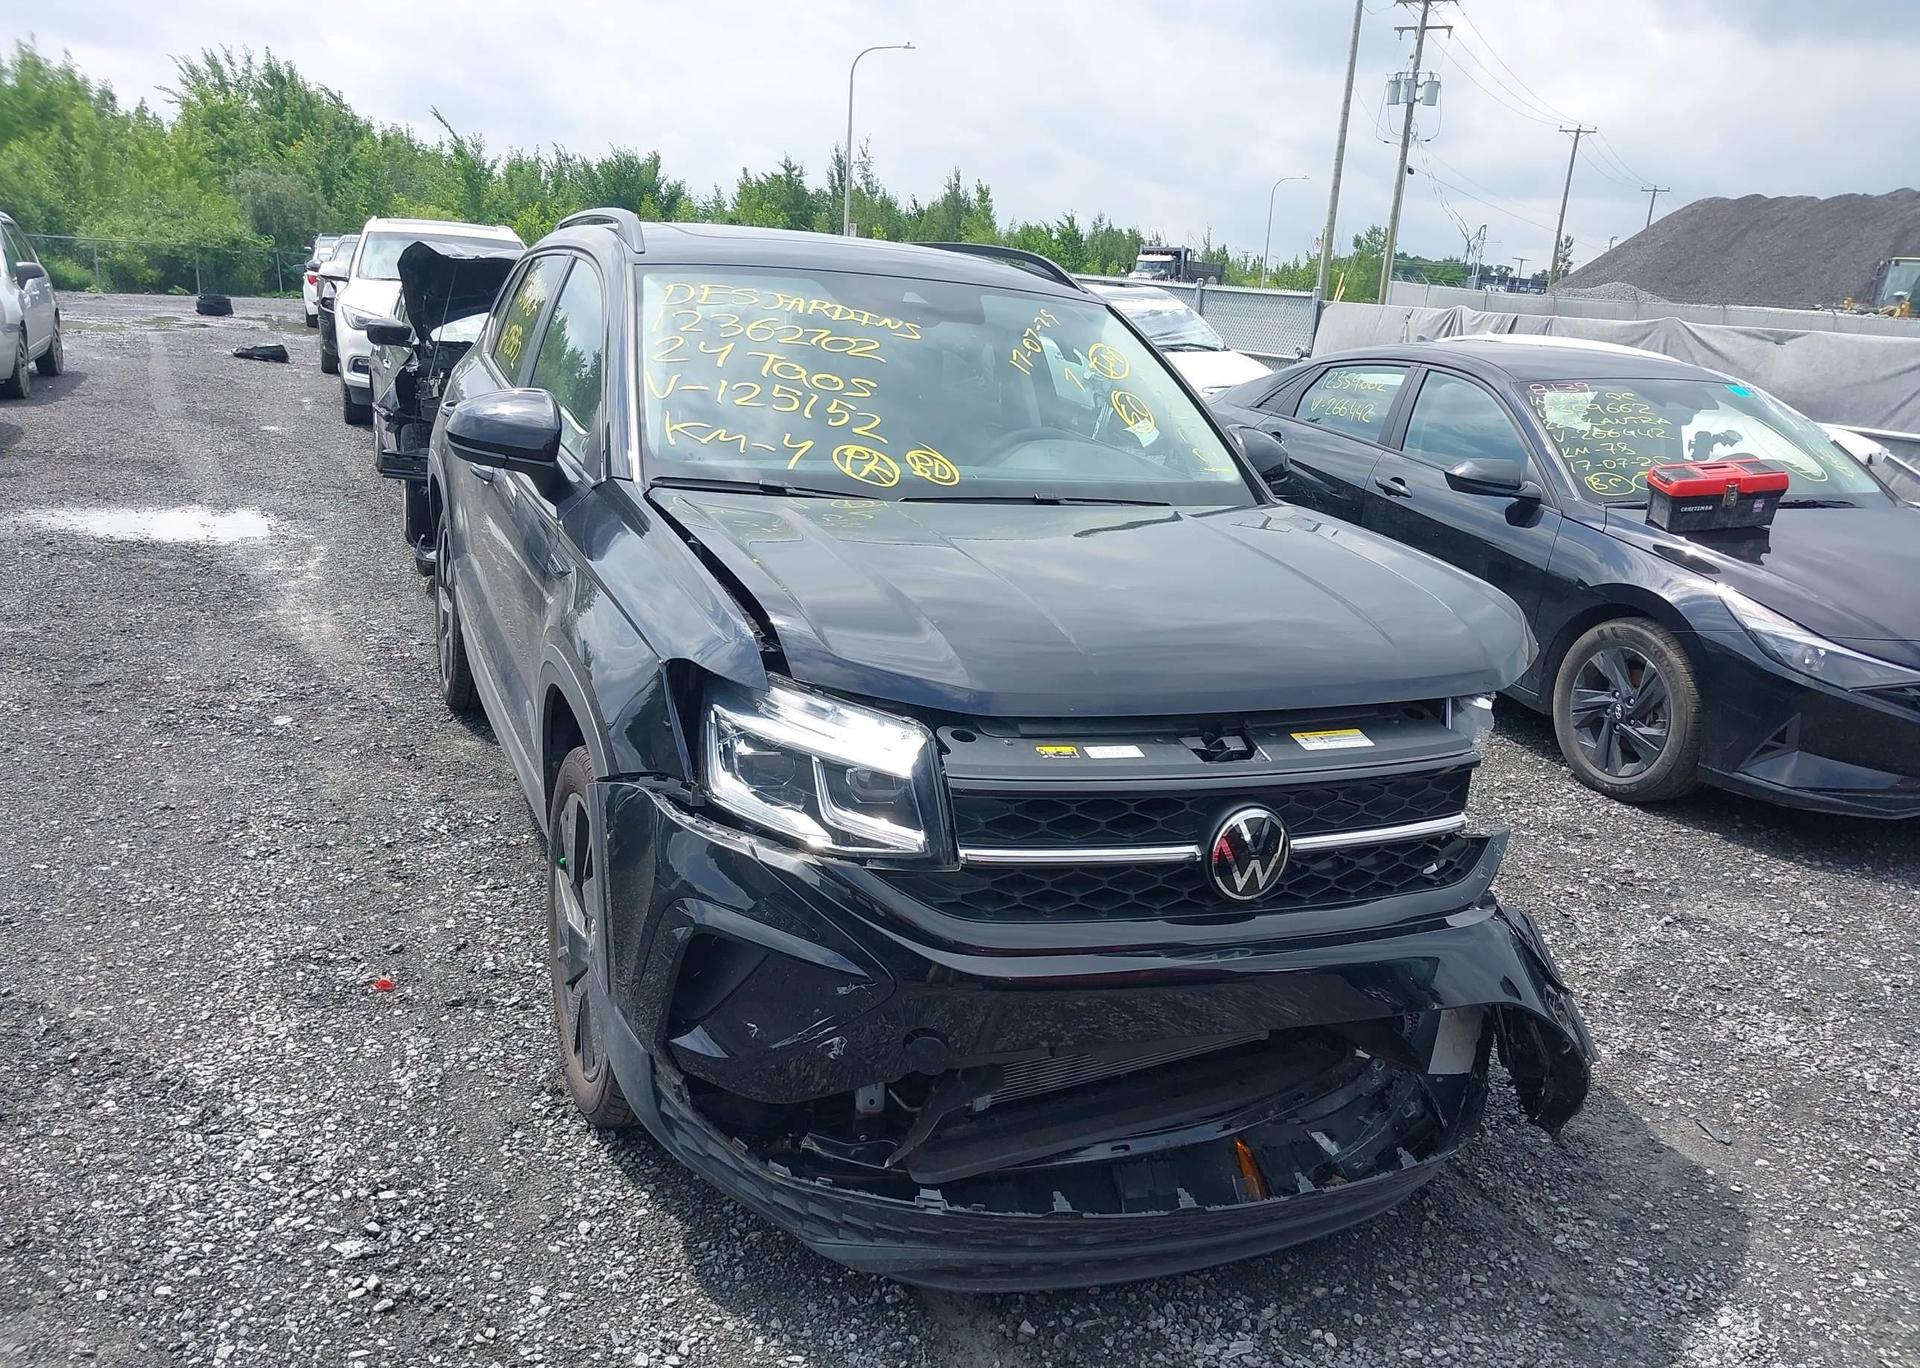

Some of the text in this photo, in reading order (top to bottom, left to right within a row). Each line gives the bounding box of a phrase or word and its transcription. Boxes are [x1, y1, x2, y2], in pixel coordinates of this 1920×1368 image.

[652, 310, 887, 363] 12362702
[664, 283, 921, 339] DESJARDINS
[653, 336, 735, 367] 24
[644, 372, 889, 444] V-125152
[664, 411, 815, 470] KM-4
[1680, 505, 1713, 513] CRAFTSMAN
